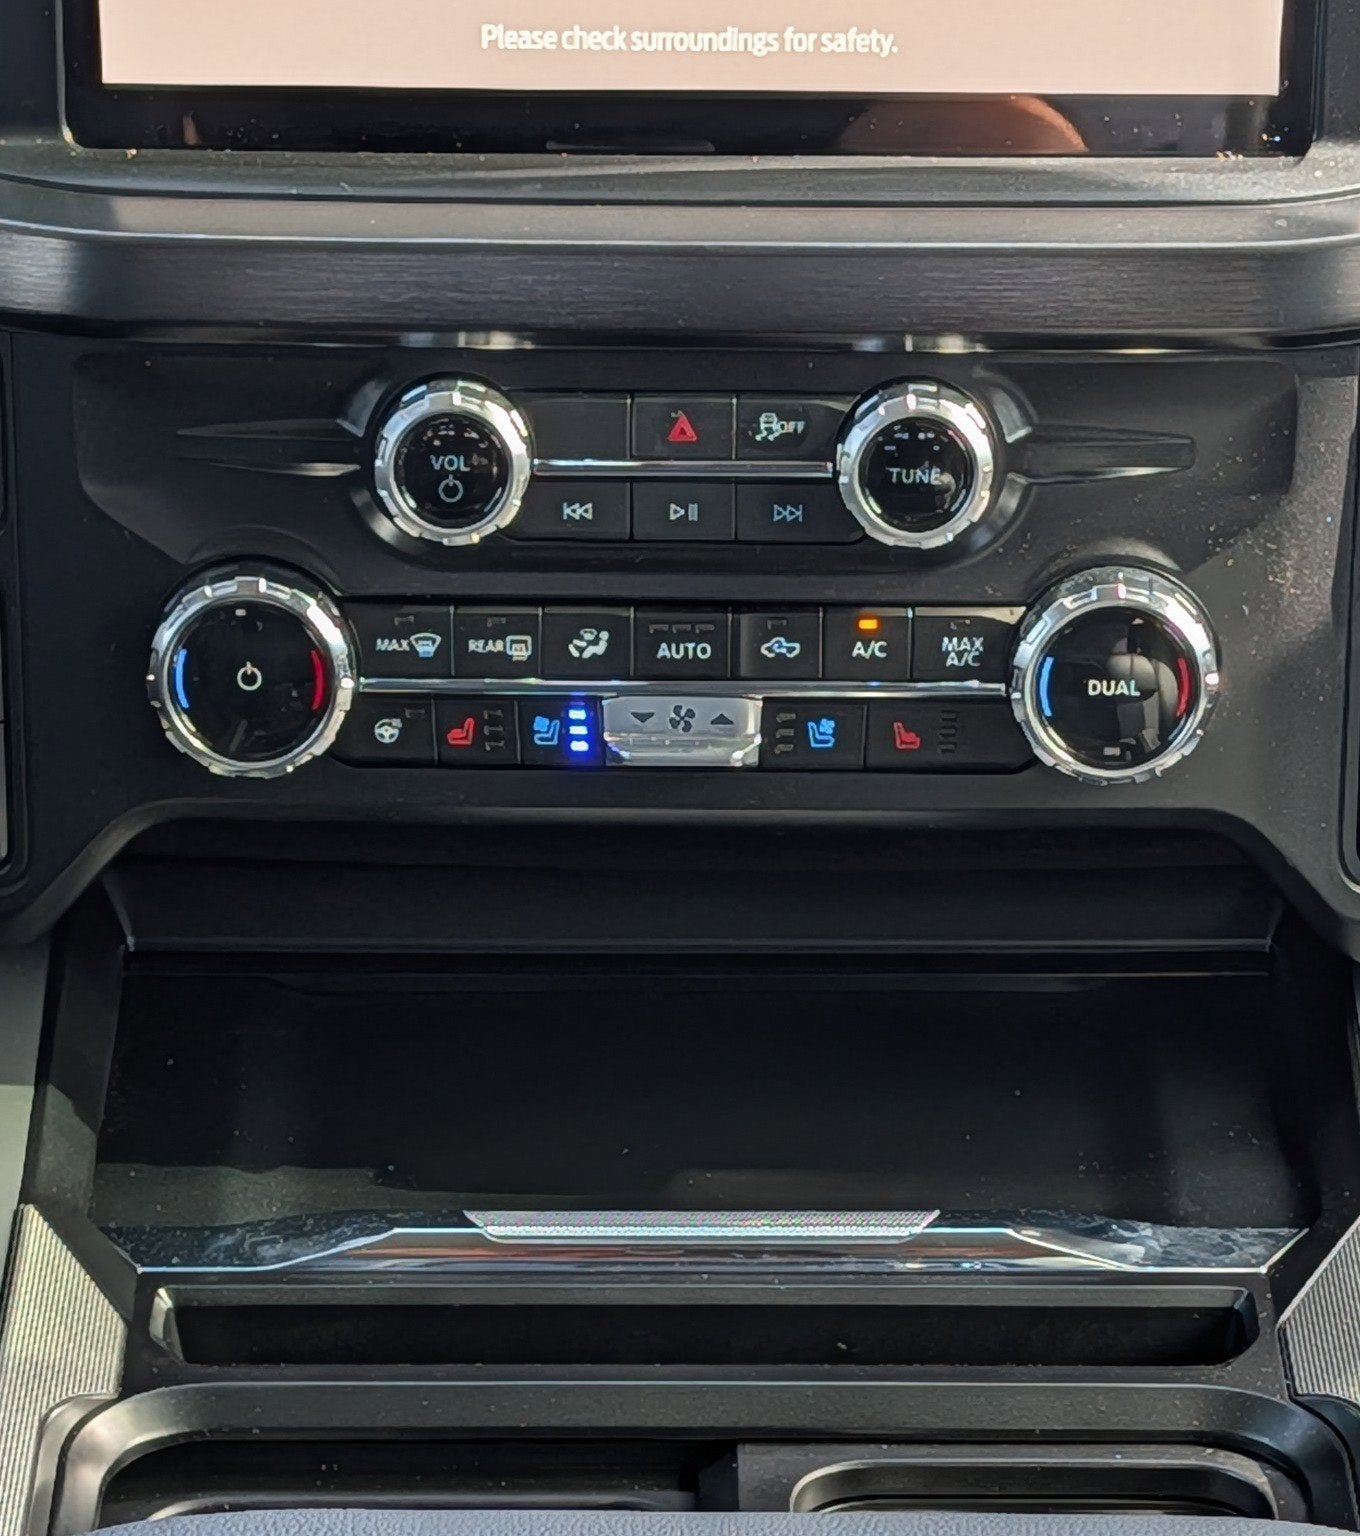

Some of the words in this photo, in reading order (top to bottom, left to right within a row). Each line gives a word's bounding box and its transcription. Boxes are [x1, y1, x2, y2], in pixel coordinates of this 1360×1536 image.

[481, 23, 558, 50] Please
[561, 25, 626, 52] check
[630, 27, 779, 57] surroundings
[783, 26, 818, 52] for
[820, 27, 899, 58] safety.
[779, 419, 805, 434] OFF
[430, 455, 471, 472] VOL
[889, 468, 941, 485] TUNE
[376, 638, 409, 652] MAX
[468, 639, 503, 653] REAR
[656, 642, 712, 659] AUTO
[852, 641, 888, 659] A/C
[942, 637, 984, 652] MAX
[945, 651, 981, 668] A/C
[1088, 679, 1140, 697] DUAL
